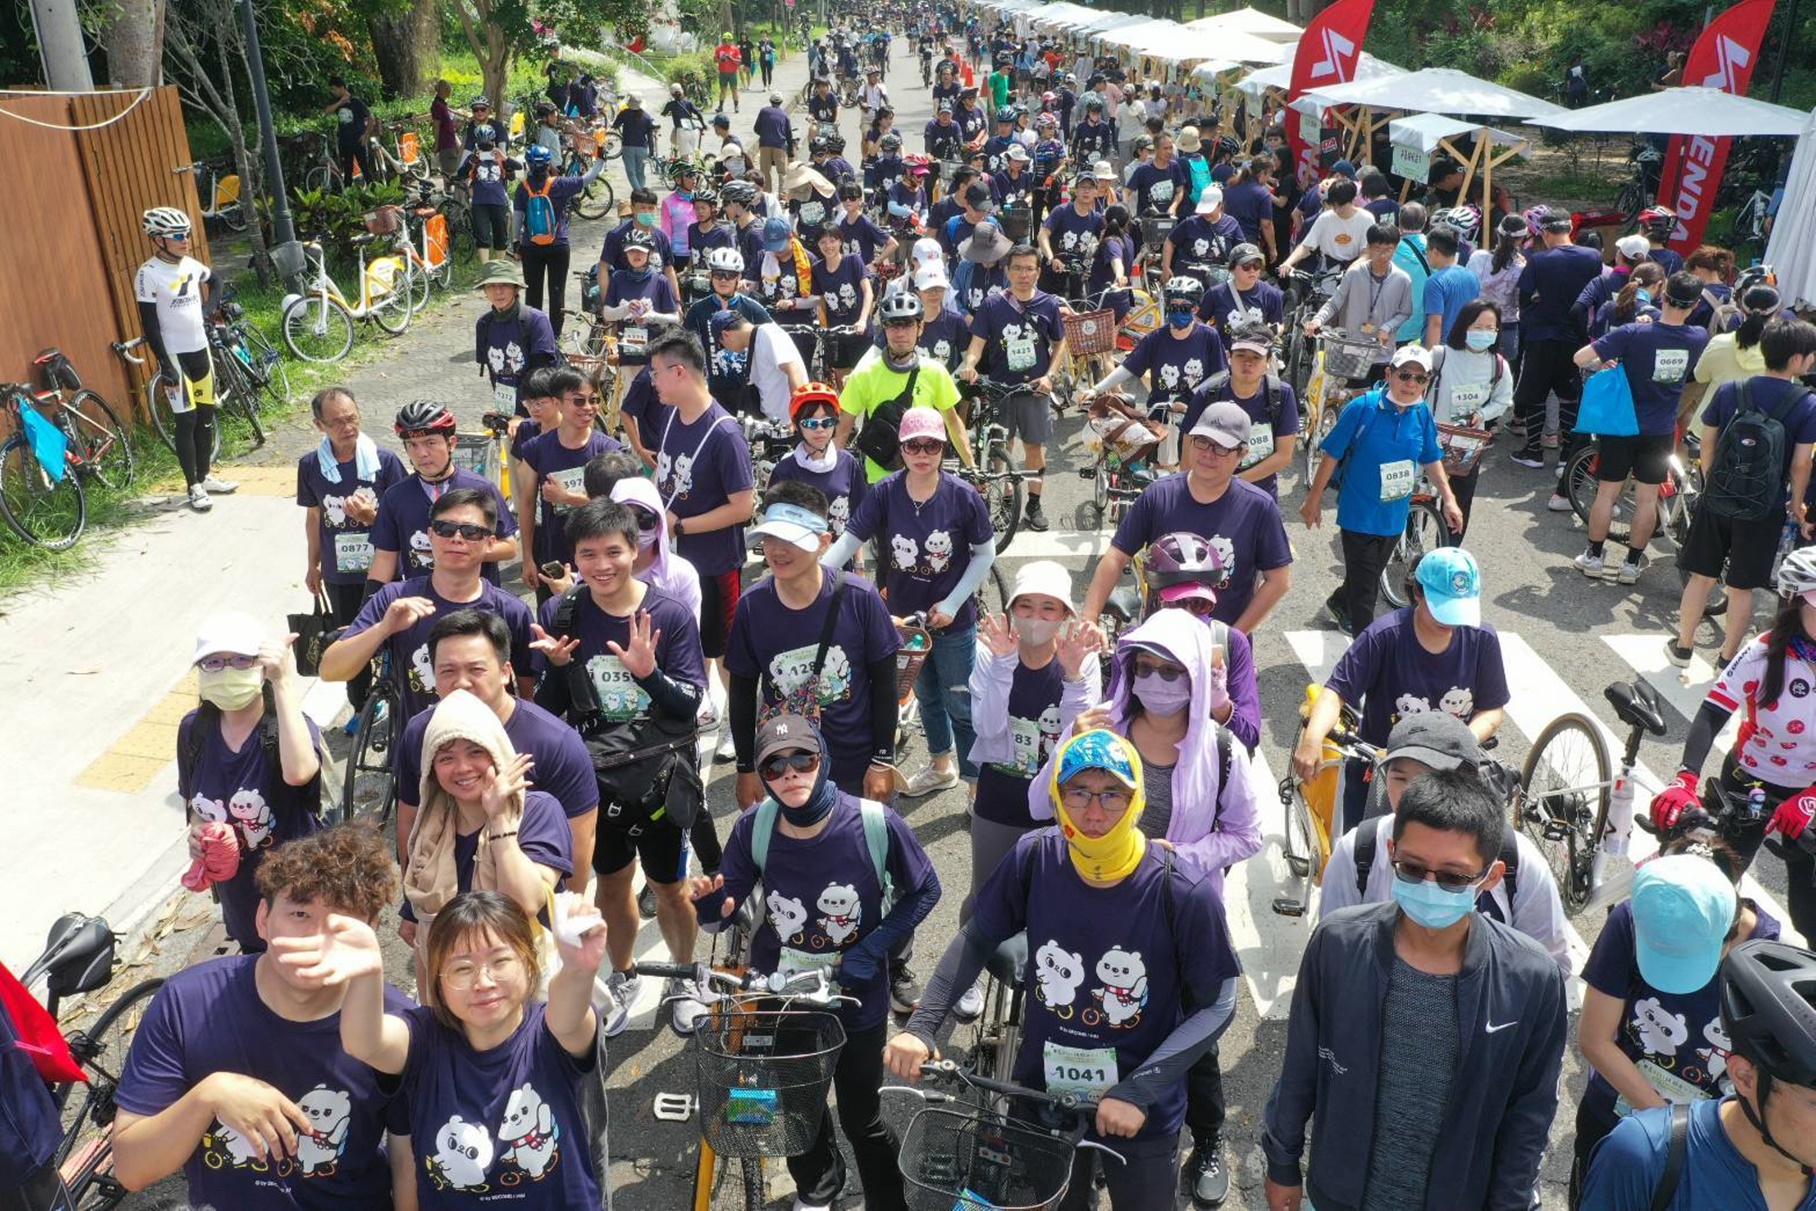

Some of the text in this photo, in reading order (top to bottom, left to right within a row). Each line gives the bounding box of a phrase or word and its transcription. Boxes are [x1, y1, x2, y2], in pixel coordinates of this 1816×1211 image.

[1676, 134, 1718, 243] ENDA
[1660, 357, 1683, 365] 0669
[1457, 393, 1480, 402] 1304
[1249, 434, 1269, 446] 088
[1386, 470, 1410, 481] 0838
[563, 479, 583, 490] 397
[341, 544, 368, 553] 0877
[792, 660, 817, 677] 128
[1726, 647, 1752, 678] GIANT
[601, 671, 631, 683] 035
[1014, 732, 1032, 747] 83
[1055, 1065, 1105, 1083] 1041
